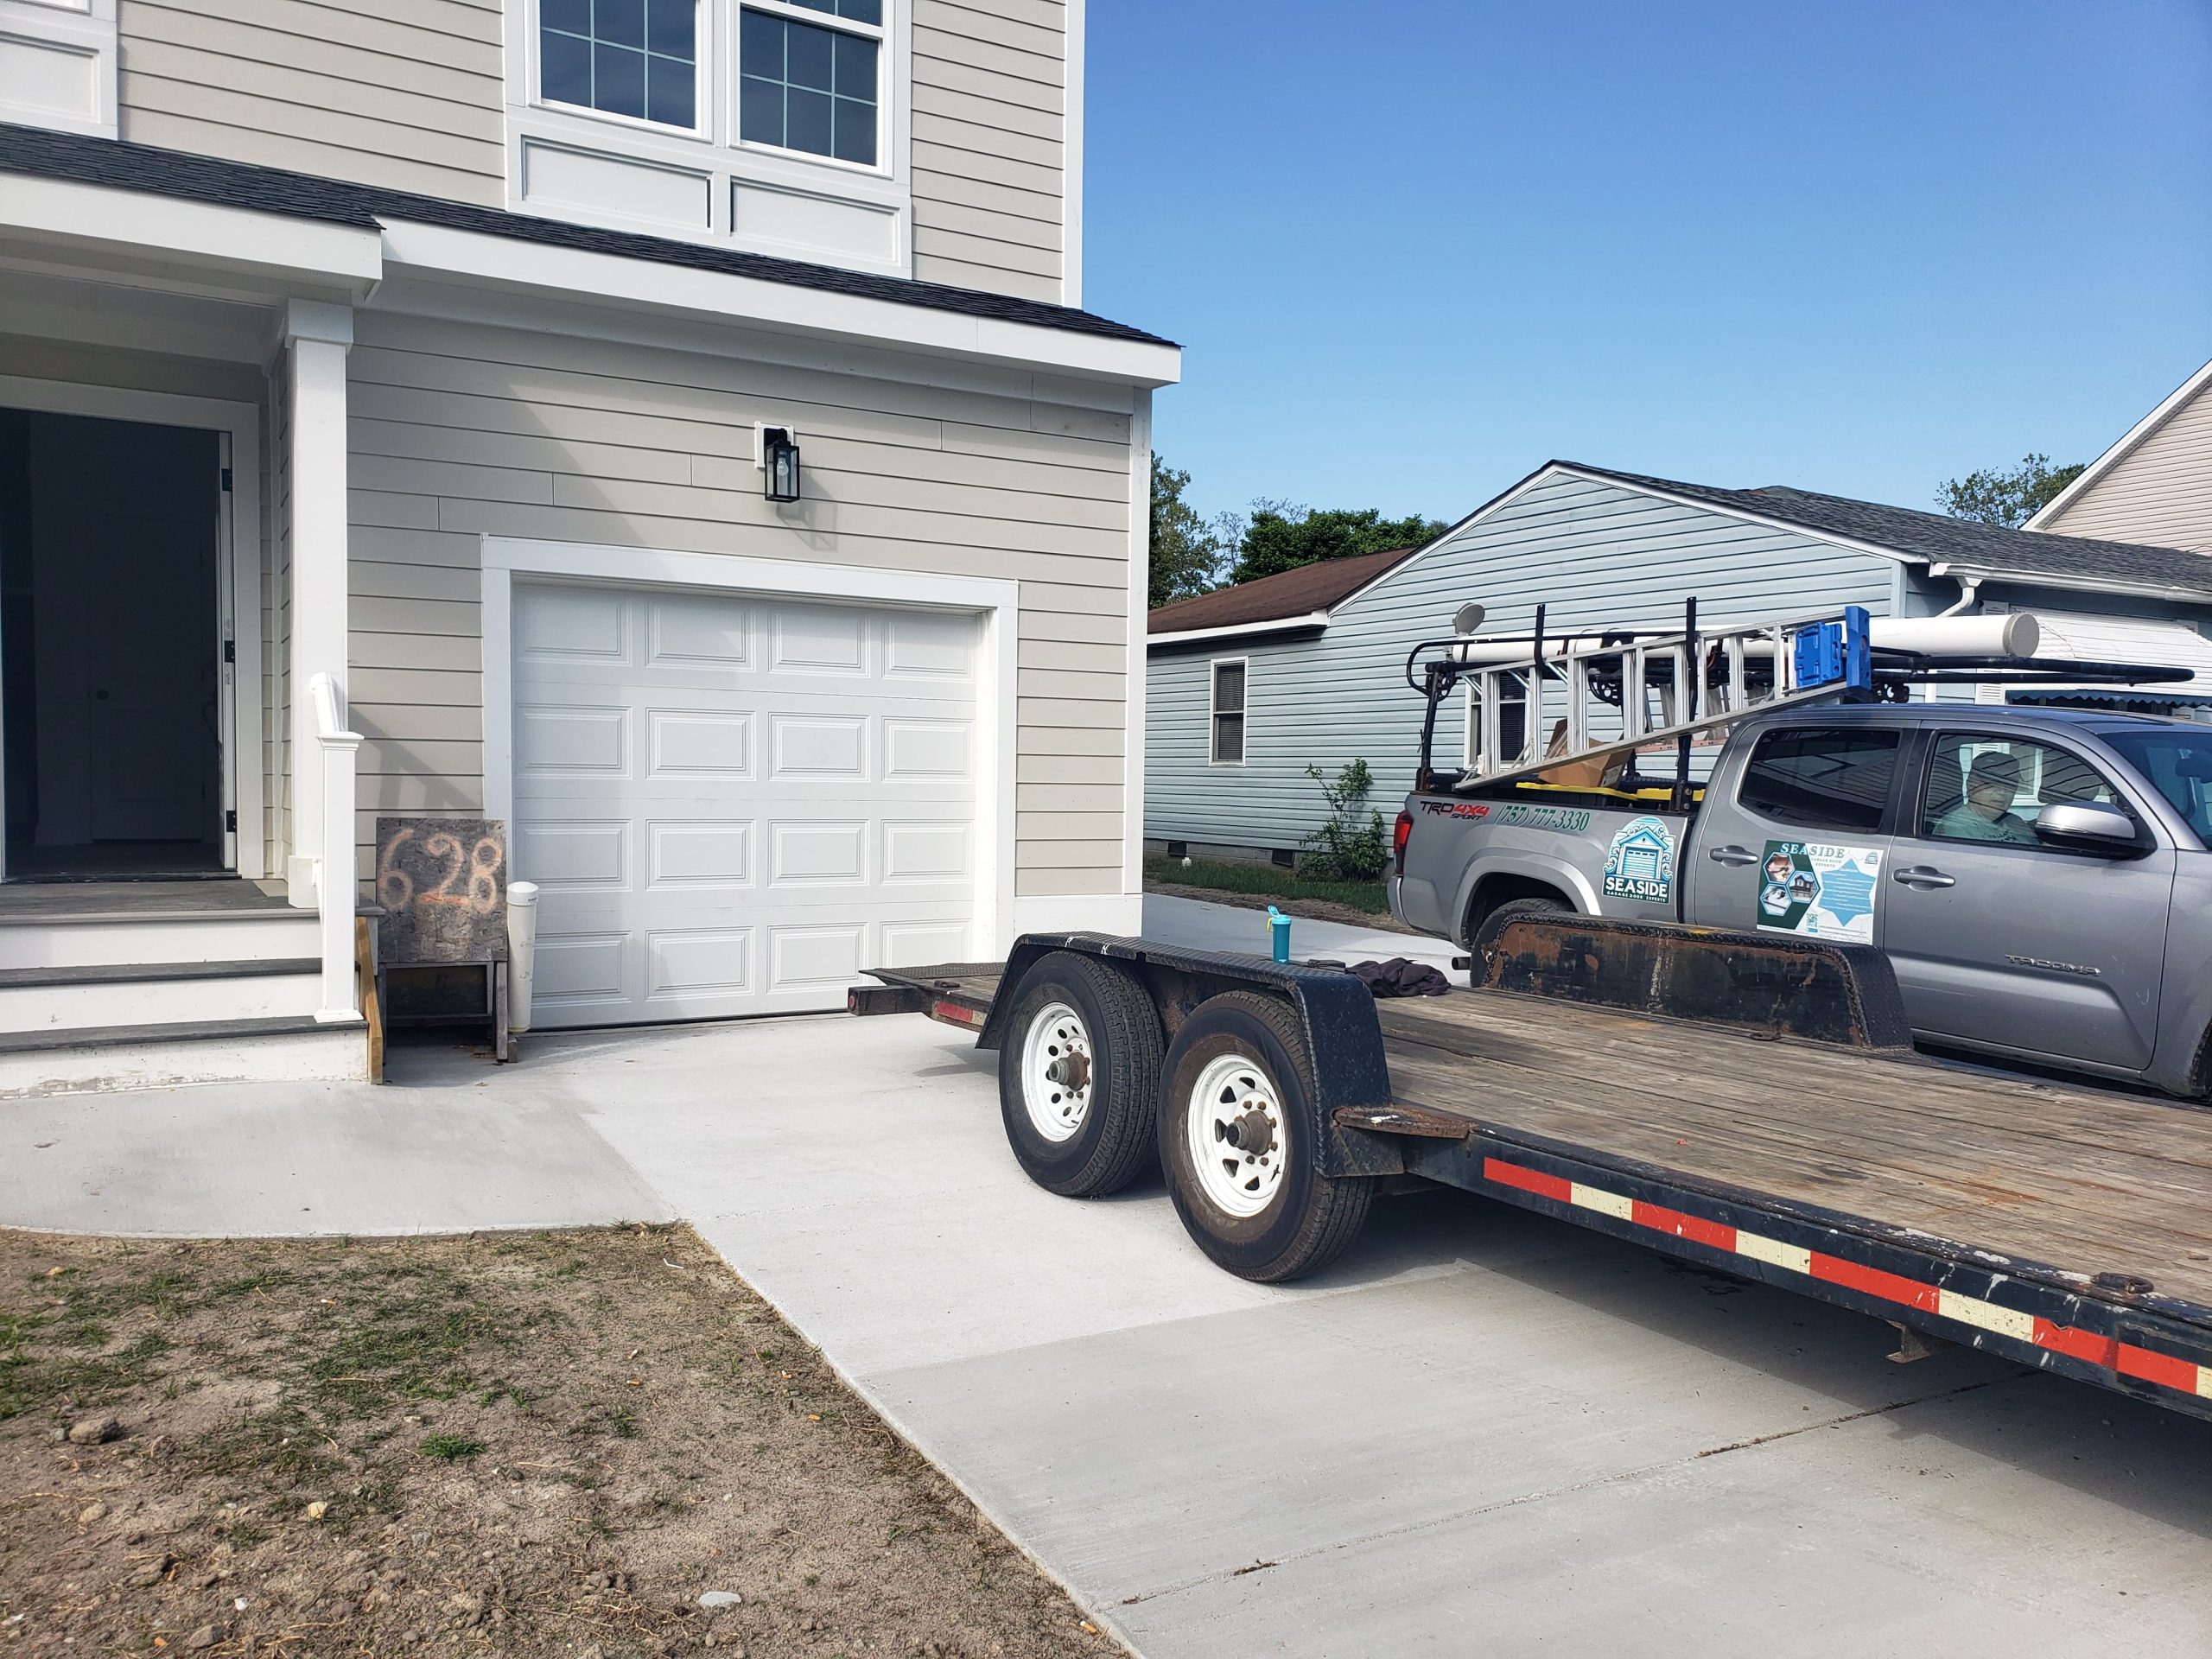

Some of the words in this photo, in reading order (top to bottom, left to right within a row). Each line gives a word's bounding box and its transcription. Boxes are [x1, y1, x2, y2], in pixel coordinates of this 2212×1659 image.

[1420, 800, 1454, 816] TRD
[1494, 804, 1530, 827] (757)
[1529, 807, 1591, 831] 777-3330
[1781, 843, 1846, 858] SEASIDE
[378, 828, 503, 914] 628
[1605, 876, 1668, 898] SEASIDE
[2004, 954, 2101, 977] TACOMA
